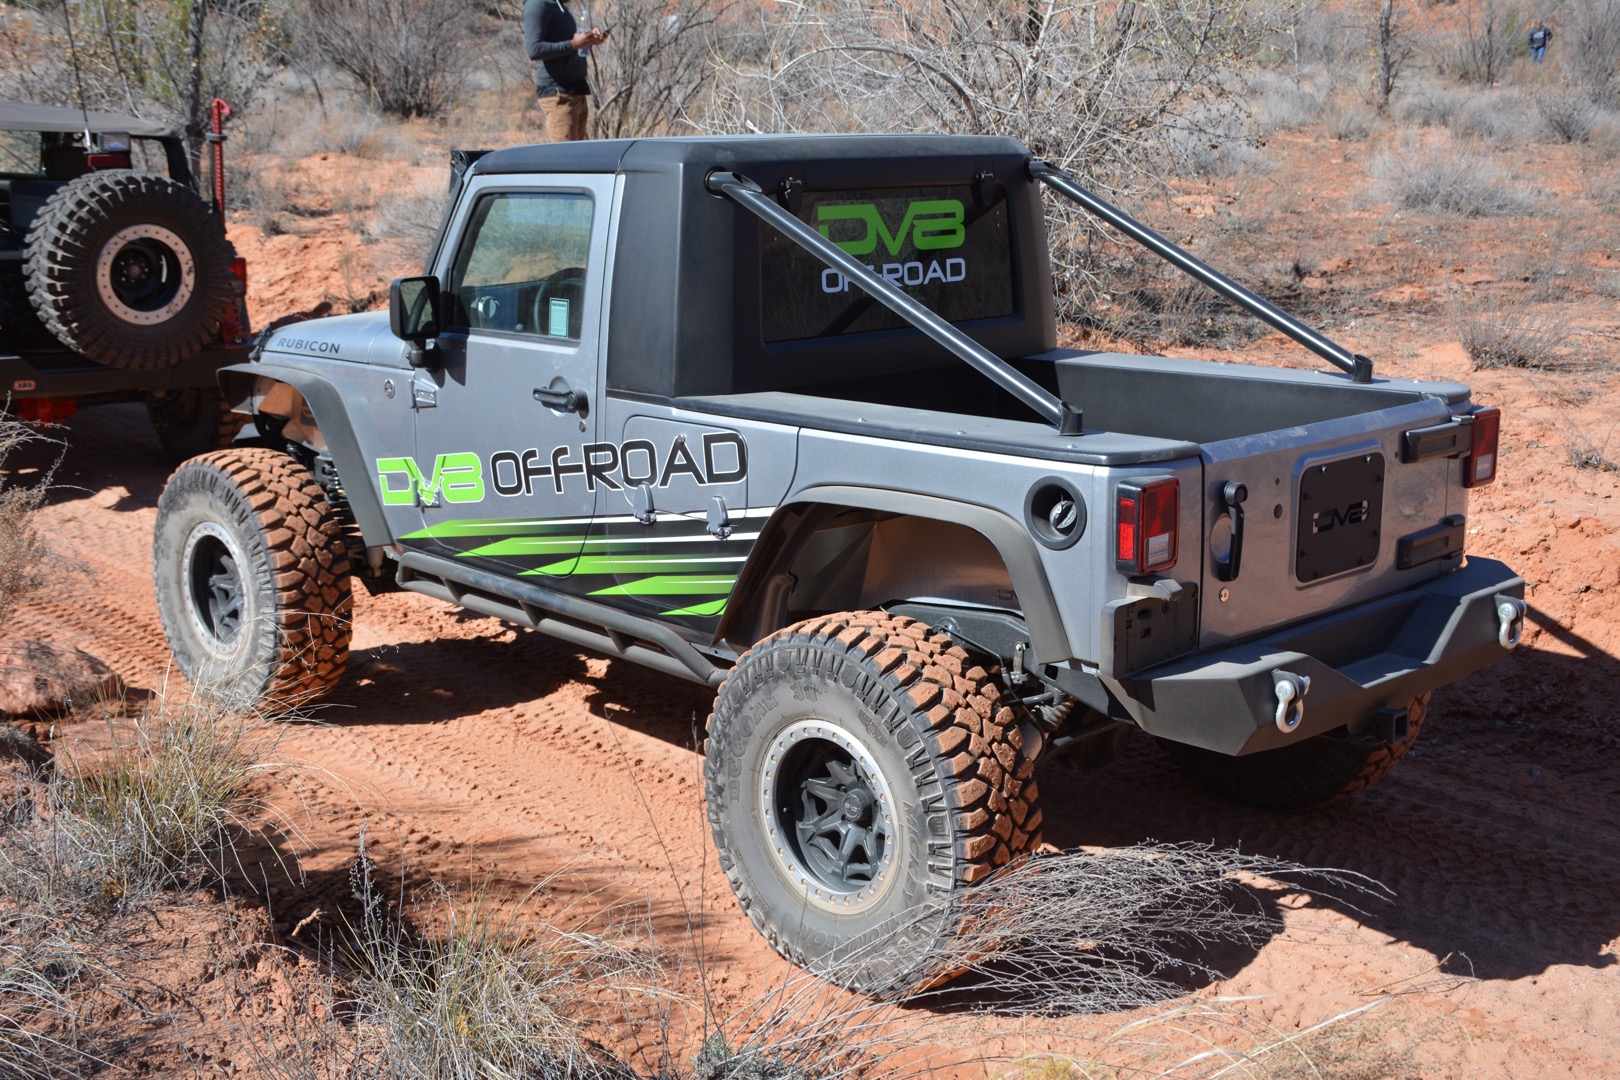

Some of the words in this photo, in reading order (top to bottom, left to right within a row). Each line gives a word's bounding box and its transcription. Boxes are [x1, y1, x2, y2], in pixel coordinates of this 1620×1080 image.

[818, 200, 965, 256] DV8
[822, 258, 966, 293] OROAD
[277, 338, 341, 354] RUBICON
[376, 452, 485, 505] DV8
